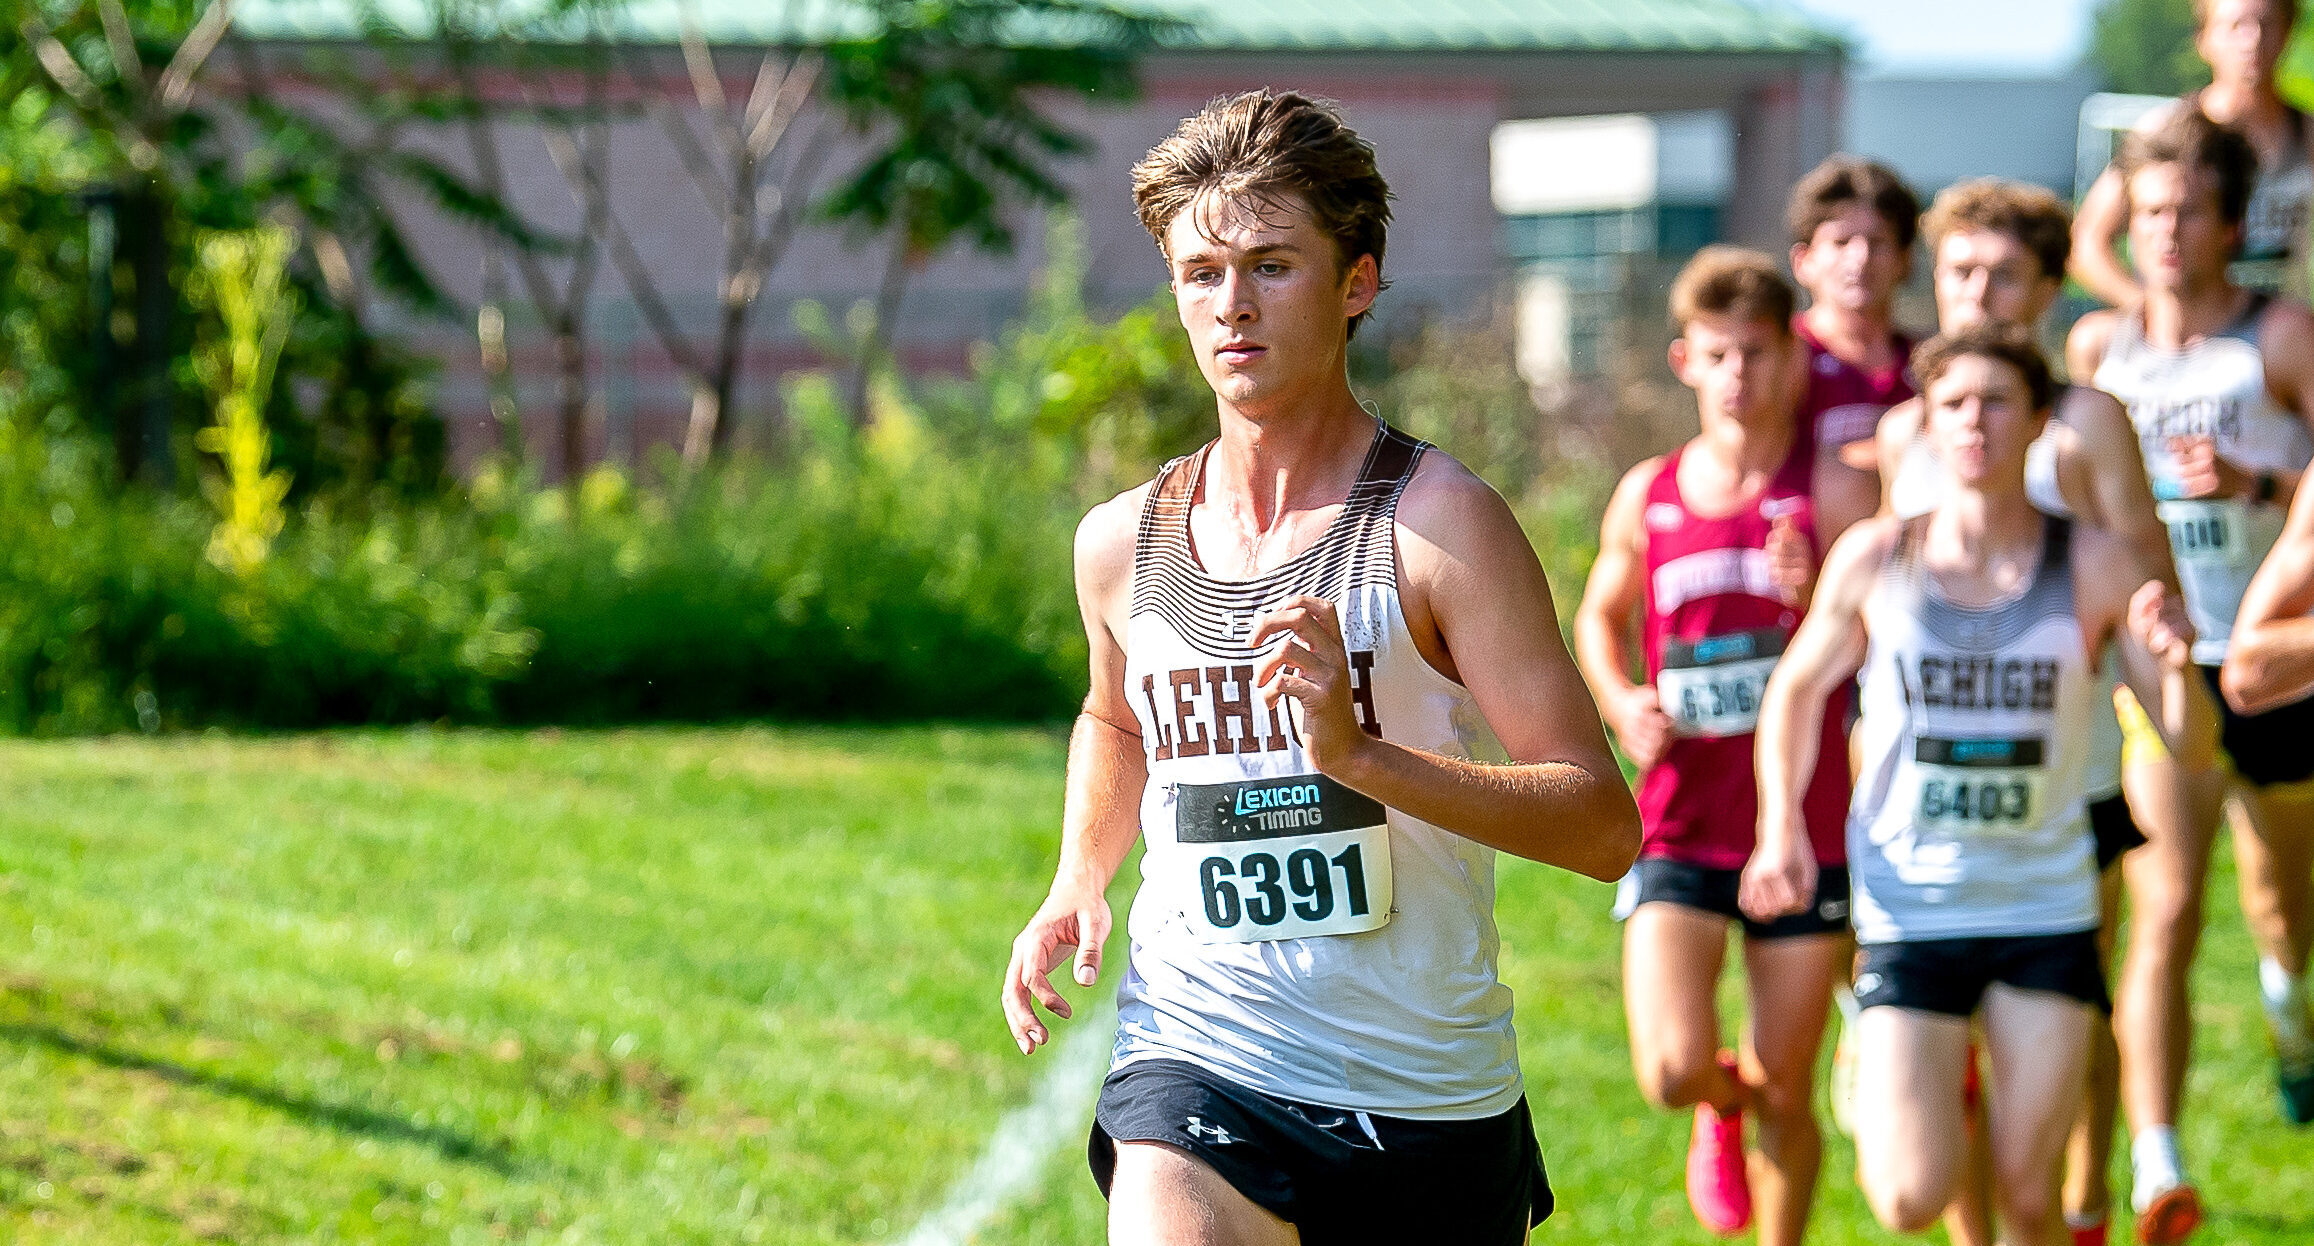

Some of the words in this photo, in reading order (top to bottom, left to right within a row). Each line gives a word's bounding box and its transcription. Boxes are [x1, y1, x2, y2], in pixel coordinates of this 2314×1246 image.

[1141, 650, 1384, 762] LEHIH
[1235, 784, 1320, 815] LEXICON
[1249, 807, 1323, 831] TIMING
[1922, 780, 2030, 822] 6403
[1199, 842, 1370, 929] 6391
